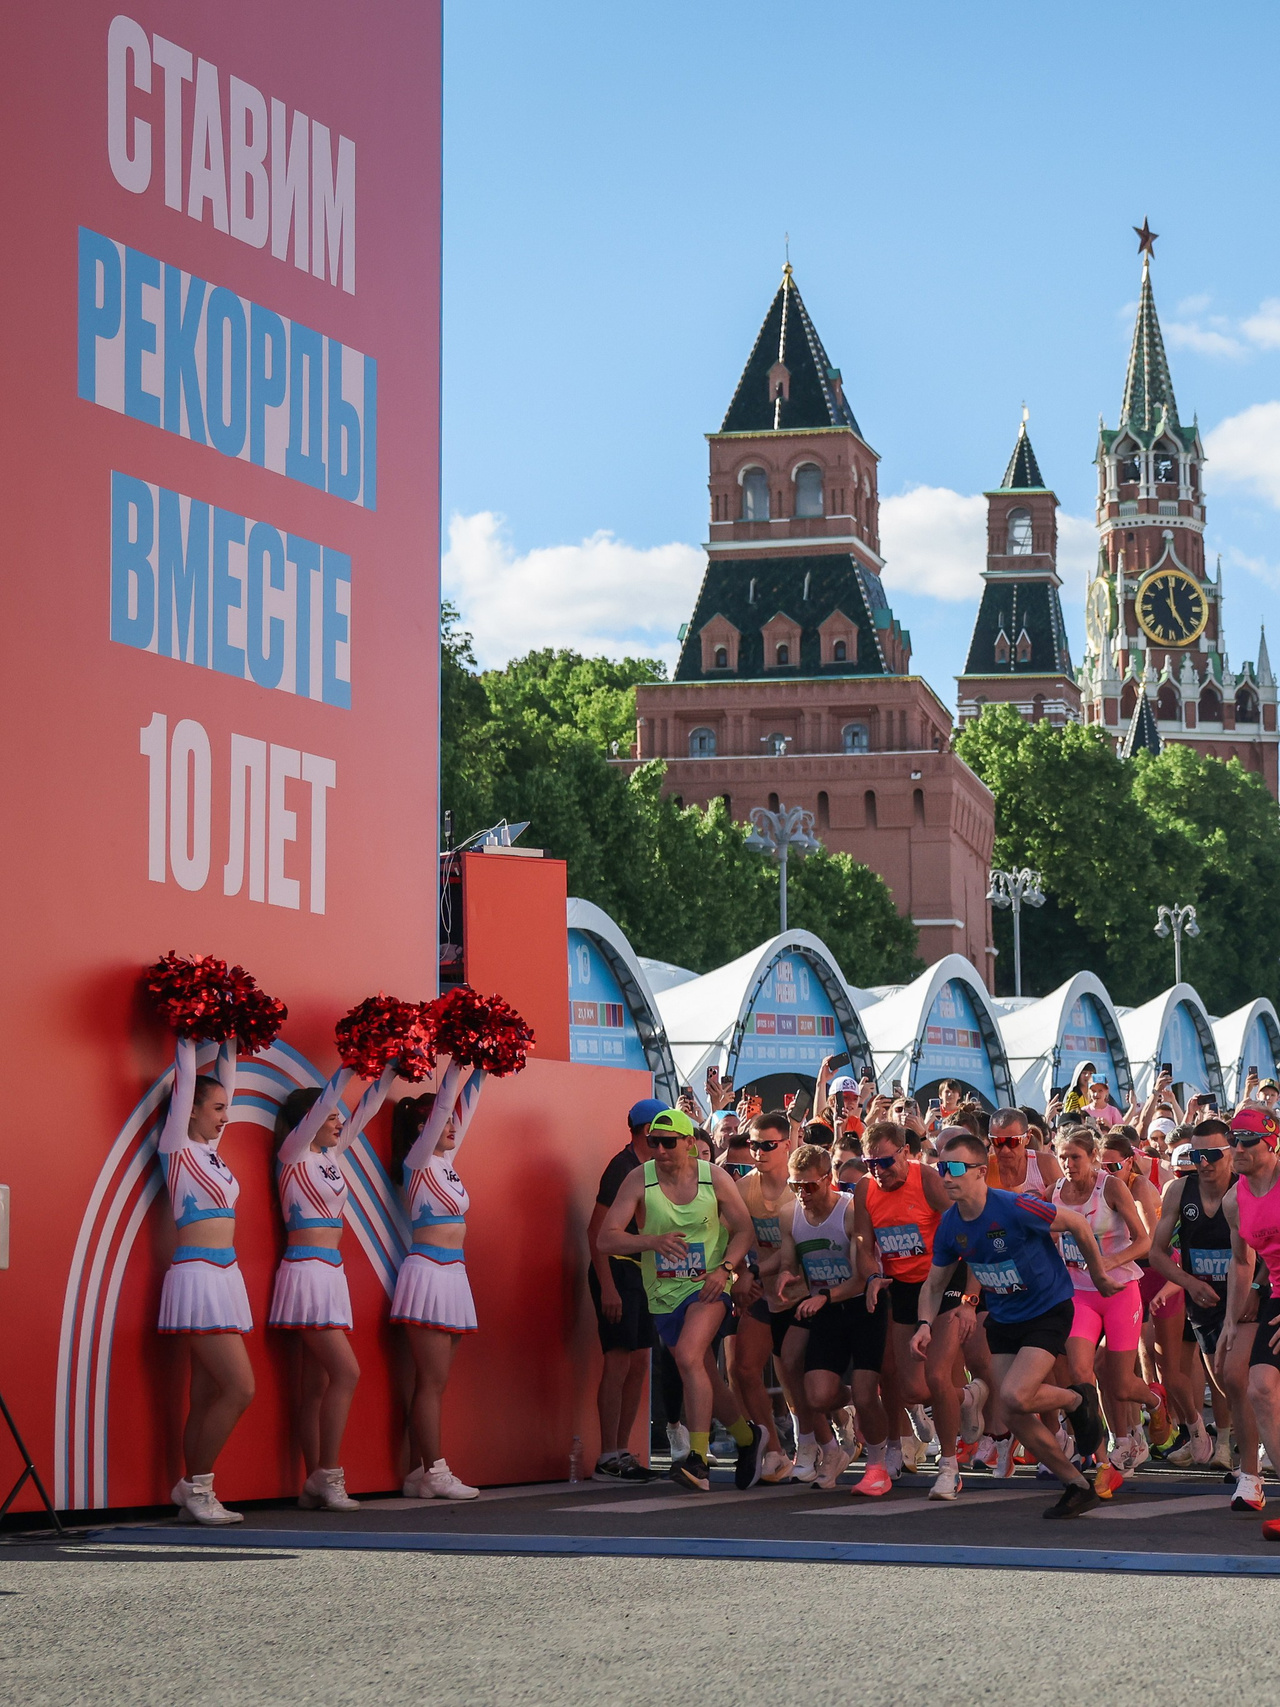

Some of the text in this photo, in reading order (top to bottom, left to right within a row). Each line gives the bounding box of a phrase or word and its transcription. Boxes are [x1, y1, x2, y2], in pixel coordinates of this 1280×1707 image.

[107, 14, 356, 296] СТАВИМ
[77, 224, 378, 512] РЕКОРДЫ
[109, 468, 352, 711] ВМЕСТЕ
[139, 711, 337, 915] 10 ЛЕТ
[881, 1232, 922, 1252] 30232
[915, 1247, 923, 1255] A
[690, 1268, 698, 1277] A
[808, 1265, 851, 1280] 35240
[1212, 1274, 1226, 1282] 5KM
[1013, 1284, 1022, 1292] A
